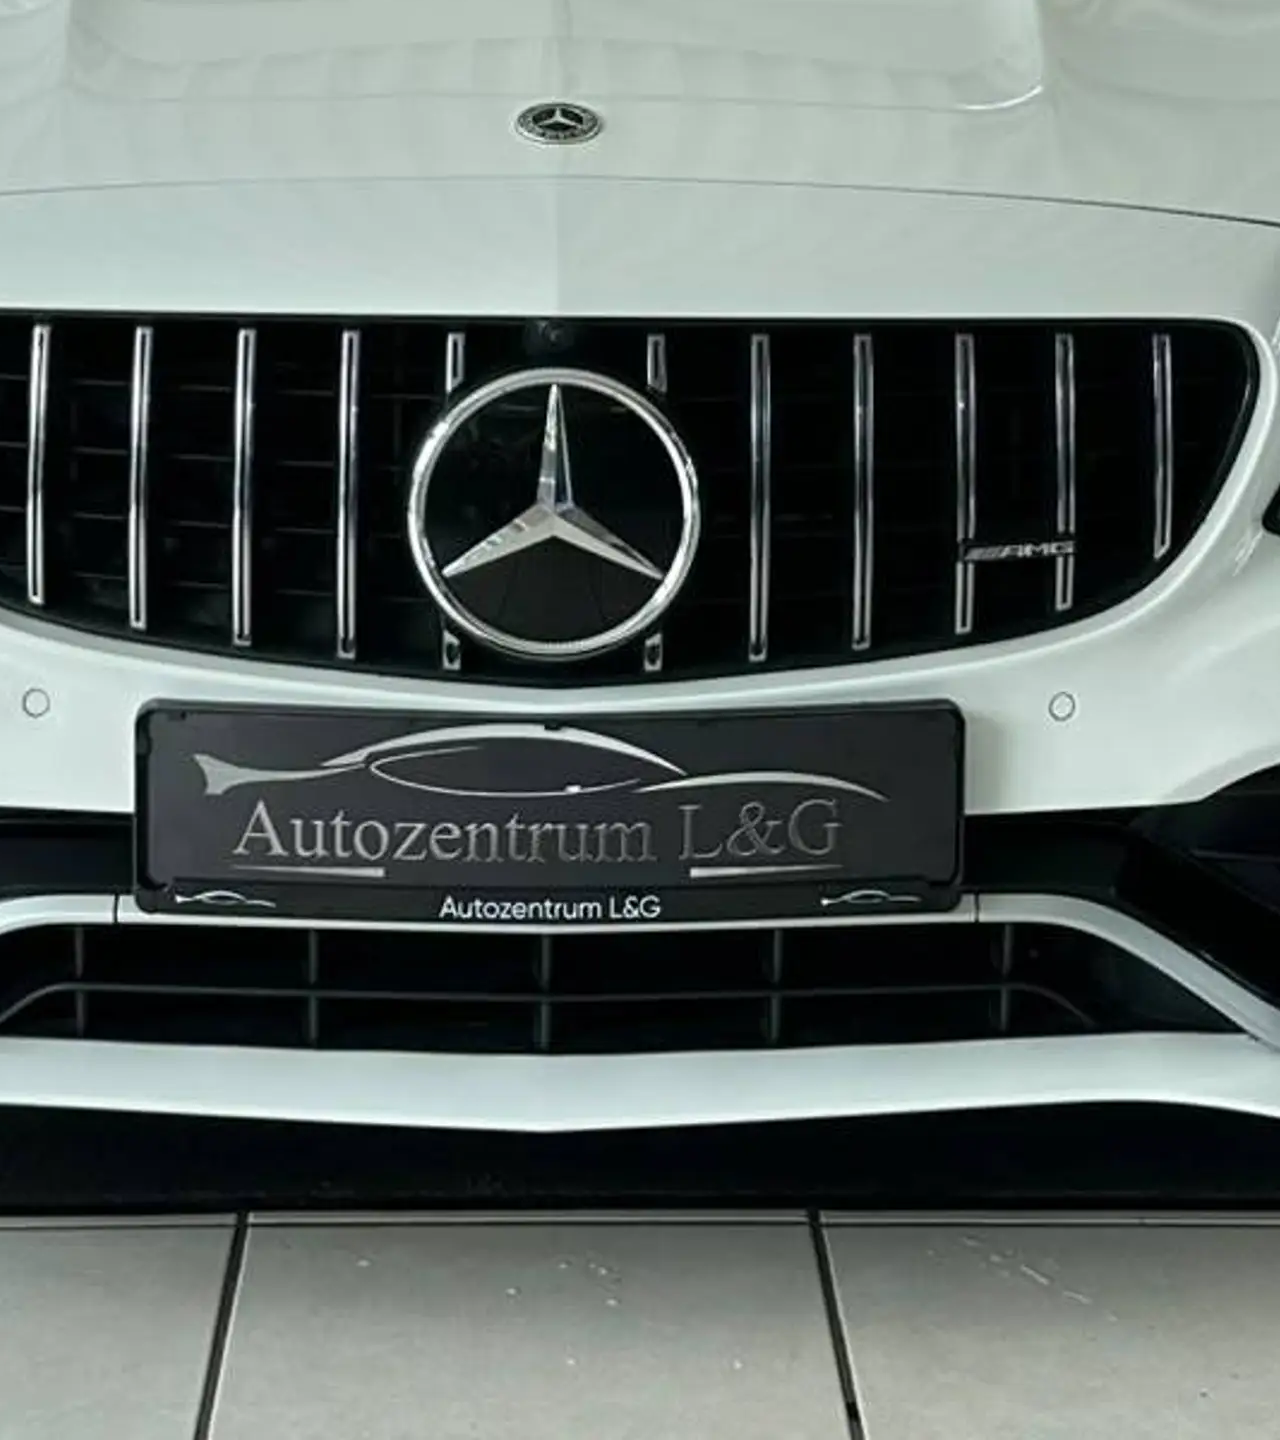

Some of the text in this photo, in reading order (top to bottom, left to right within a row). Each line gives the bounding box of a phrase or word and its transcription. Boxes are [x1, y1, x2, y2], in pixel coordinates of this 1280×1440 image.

[232, 798, 842, 862] Autozentrum L&G
[438, 894, 661, 920] Autozentrum L&G
